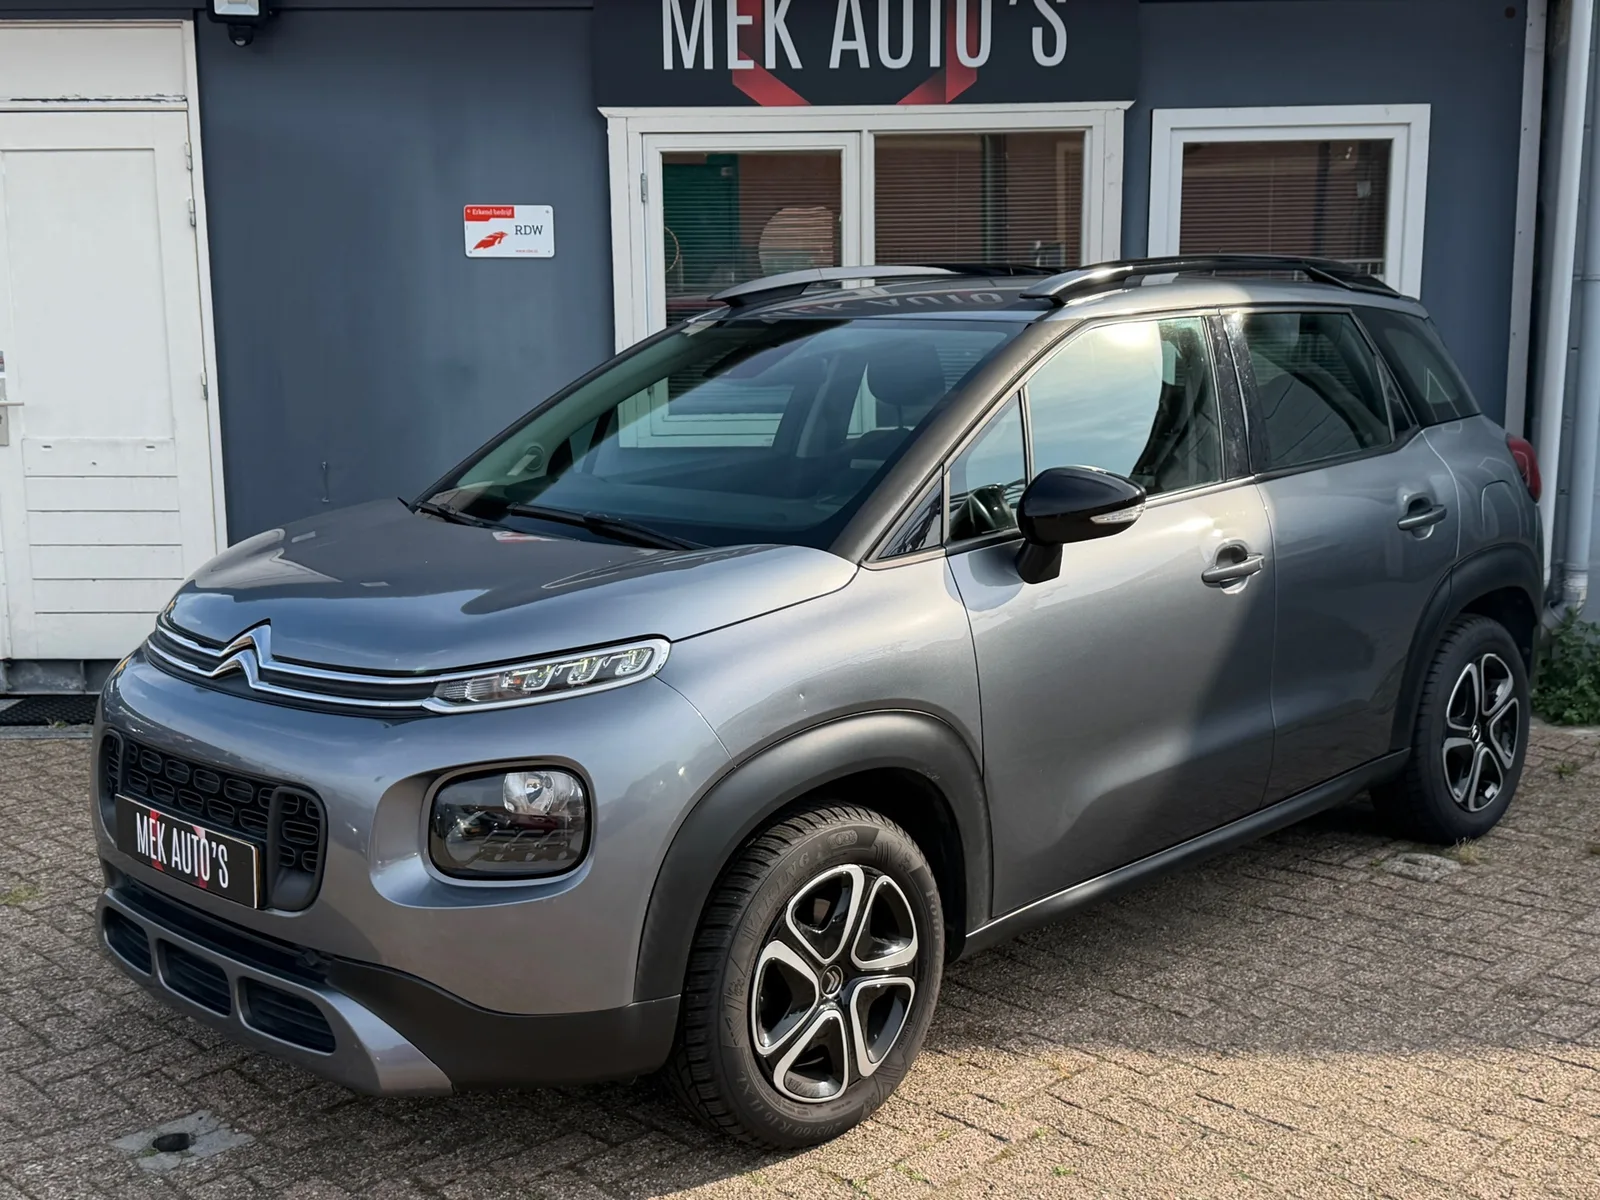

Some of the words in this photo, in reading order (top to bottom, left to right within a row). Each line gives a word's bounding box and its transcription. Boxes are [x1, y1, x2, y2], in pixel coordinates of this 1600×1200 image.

[663, 0, 802, 70] MEK
[829, 0, 1067, 69] AUTOS
[514, 224, 543, 236] RDW
[136, 812, 167, 865] MEK
[171, 827, 229, 889] AUTO'S
